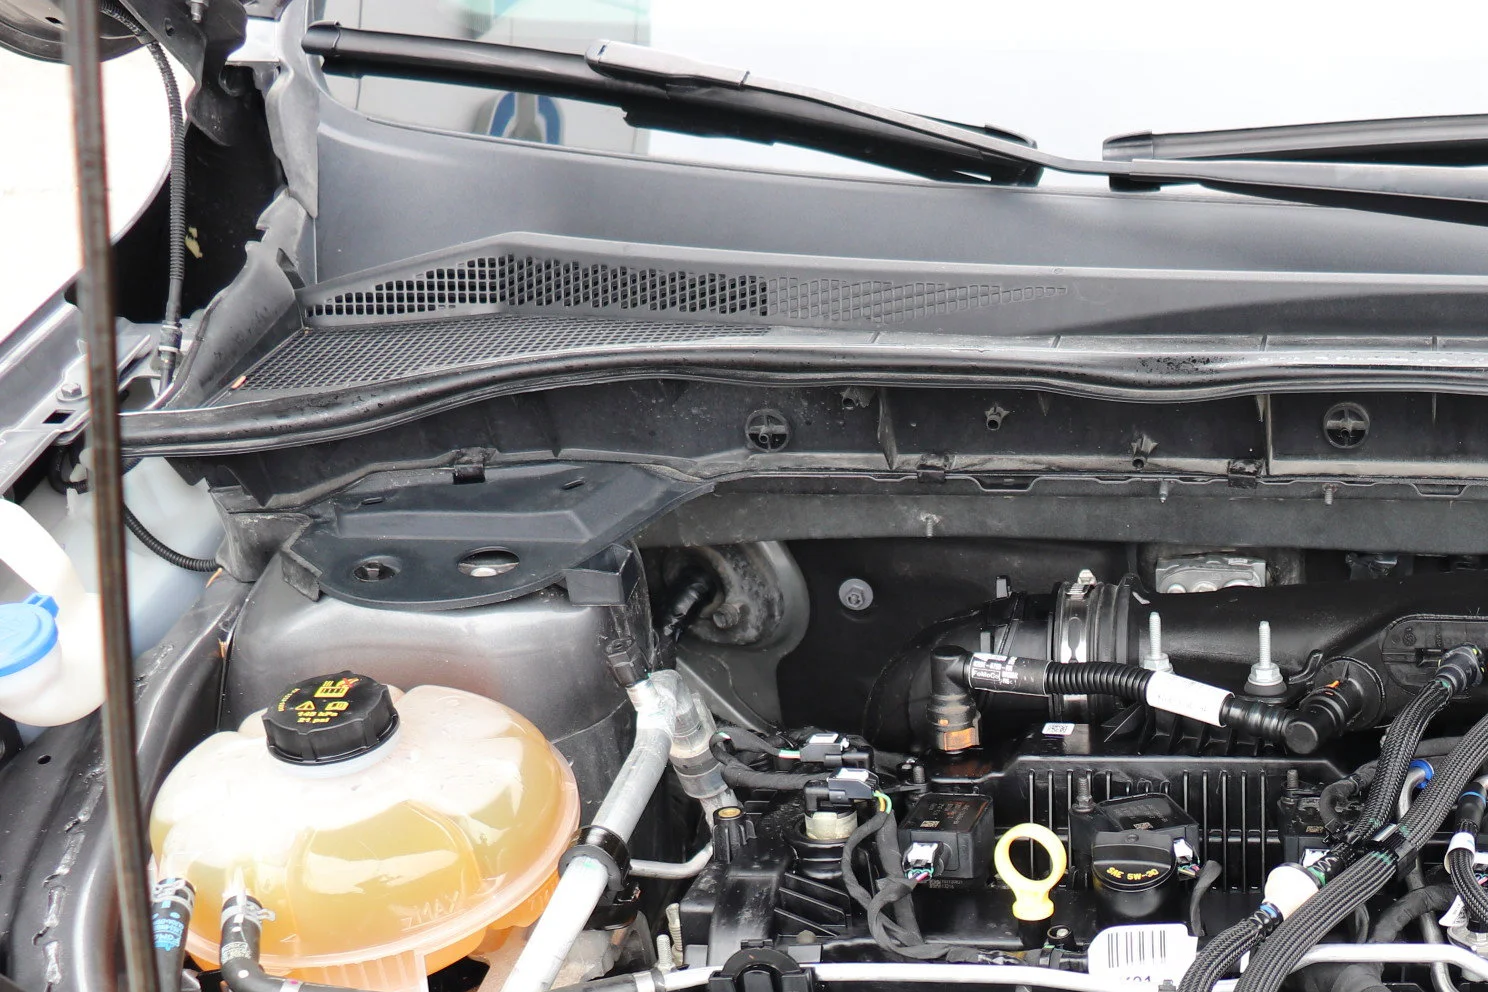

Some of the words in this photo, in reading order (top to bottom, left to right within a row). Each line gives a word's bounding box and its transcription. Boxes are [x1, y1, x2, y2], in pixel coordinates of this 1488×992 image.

[972, 670, 1000, 680] FoMoCo
[1106, 866, 1125, 879] SAE
[1126, 868, 1160, 881] 5W-30
